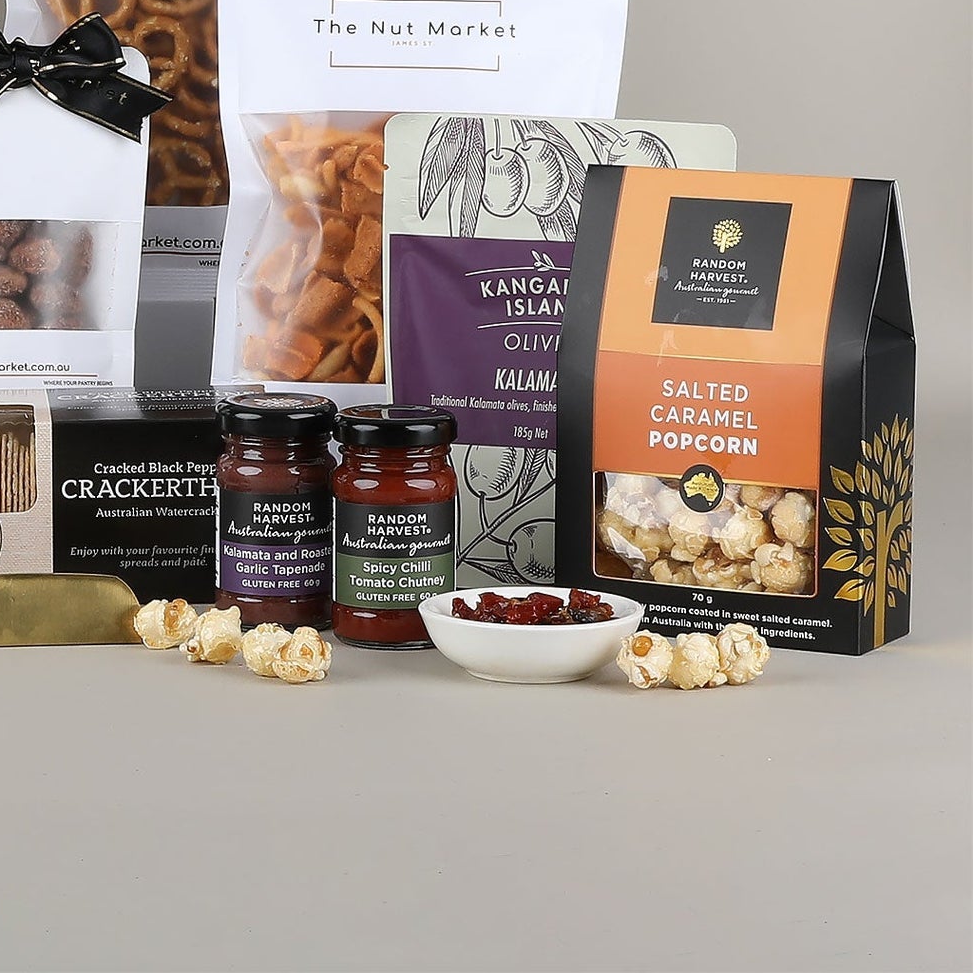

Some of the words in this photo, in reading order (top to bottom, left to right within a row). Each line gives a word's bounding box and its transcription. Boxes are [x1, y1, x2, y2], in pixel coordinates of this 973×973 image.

[313, 18, 358, 36] The
[371, 20, 414, 36] Nut
[428, 21, 517, 39] Market
[692, 258, 747, 271] RANDOM
[673, 280, 722, 293] Australian
[661, 379, 749, 403] SALTED
[430, 394, 467, 407] Traditional
[469, 397, 505, 411] Kalamata
[507, 399, 531, 413] olives,
[649, 405, 758, 430] CARAMEL
[513, 426, 534, 441] 185g
[535, 428, 549, 439] Net
[649, 430, 758, 456] POPCORN
[93, 462, 145, 474] Cracked
[148, 461, 184, 474] Black
[95, 507, 153, 518] Australian
[253, 502, 311, 513] RANDOM
[368, 513, 427, 524] RANDOM
[227, 520, 293, 538] Australian
[70, 546, 99, 558] Enjoy
[101, 545, 124, 556] with
[125, 547, 150, 558] your
[151, 544, 199, 557] favourite
[342, 532, 408, 550] Australian
[408, 533, 451, 557] gourmet
[223, 545, 271, 561] Kalamata
[274, 550, 297, 560] and
[119, 558, 159, 569] spreads
[161, 556, 181, 567] and
[235, 562, 269, 575] Garlic
[272, 562, 326, 577] Tapenade
[363, 561, 398, 575] Spicy
[400, 560, 431, 573] Chilli
[241, 579, 275, 589] GLUTEN
[277, 580, 300, 589] FREE
[304, 579, 314, 587] 60
[349, 574, 395, 588] Tomato
[398, 575, 446, 588] Chutney
[356, 592, 390, 602] GLUTEN
[392, 593, 416, 602] FREE
[692, 593, 704, 602] 70
[706, 595, 713, 604] g
[649, 604, 687, 615] popcorn
[688, 608, 720, 618] coated
[721, 609, 731, 619] in
[732, 612, 760, 622] sweet
[761, 614, 791, 625] salted
[792, 617, 834, 629] caramel.
[652, 616, 692, 628] Australia
[693, 620, 714, 630] with
[760, 626, 817, 641] ingredients.
